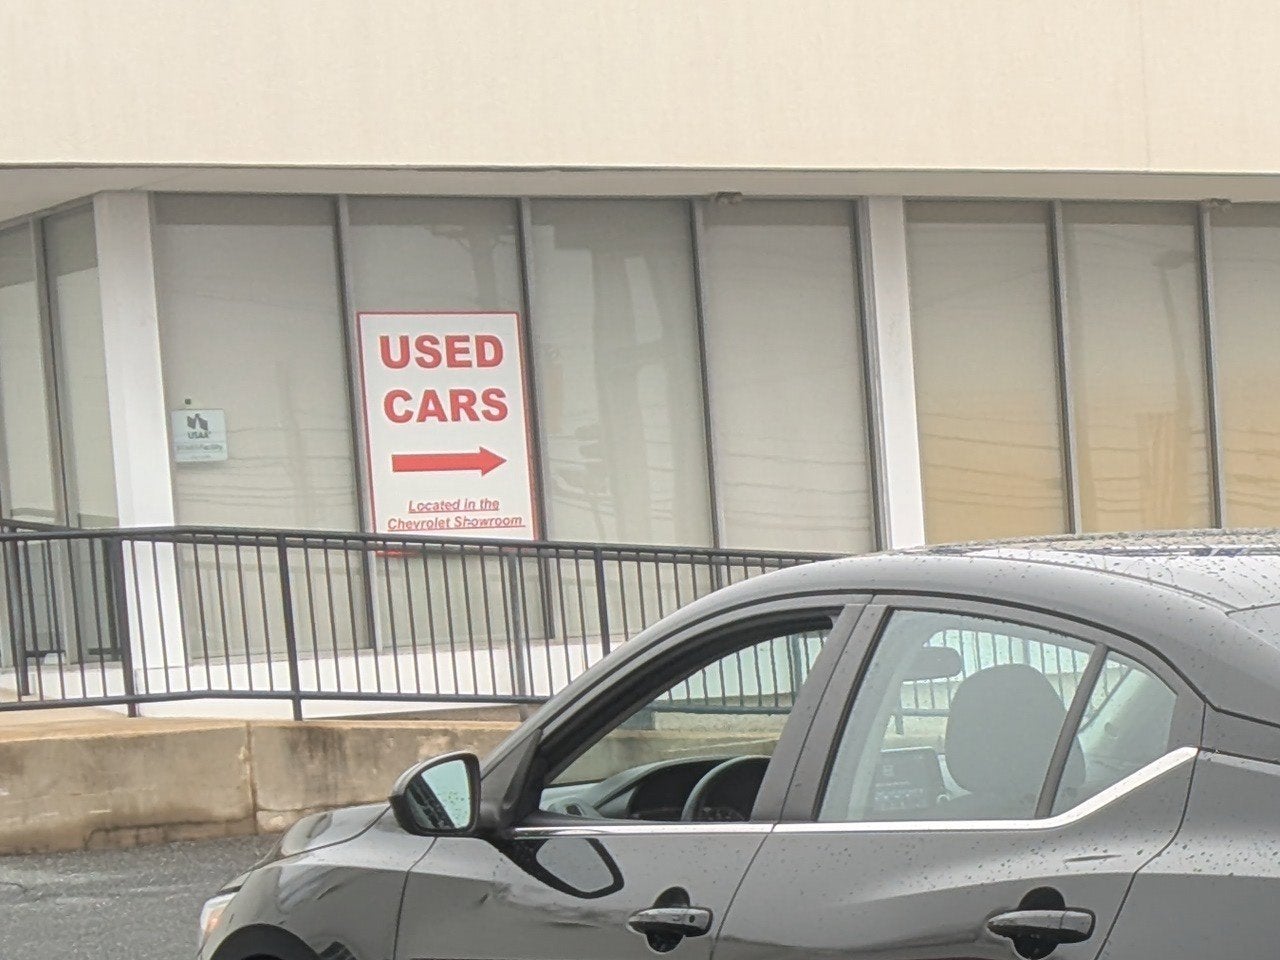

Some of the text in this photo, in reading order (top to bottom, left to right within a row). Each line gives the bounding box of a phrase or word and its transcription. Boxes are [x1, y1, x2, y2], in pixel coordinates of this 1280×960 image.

[379, 335, 504, 369] USED
[383, 388, 509, 423] CARS
[408, 498, 500, 513] Located in the
[387, 515, 523, 531] Chevrolet Showroom
